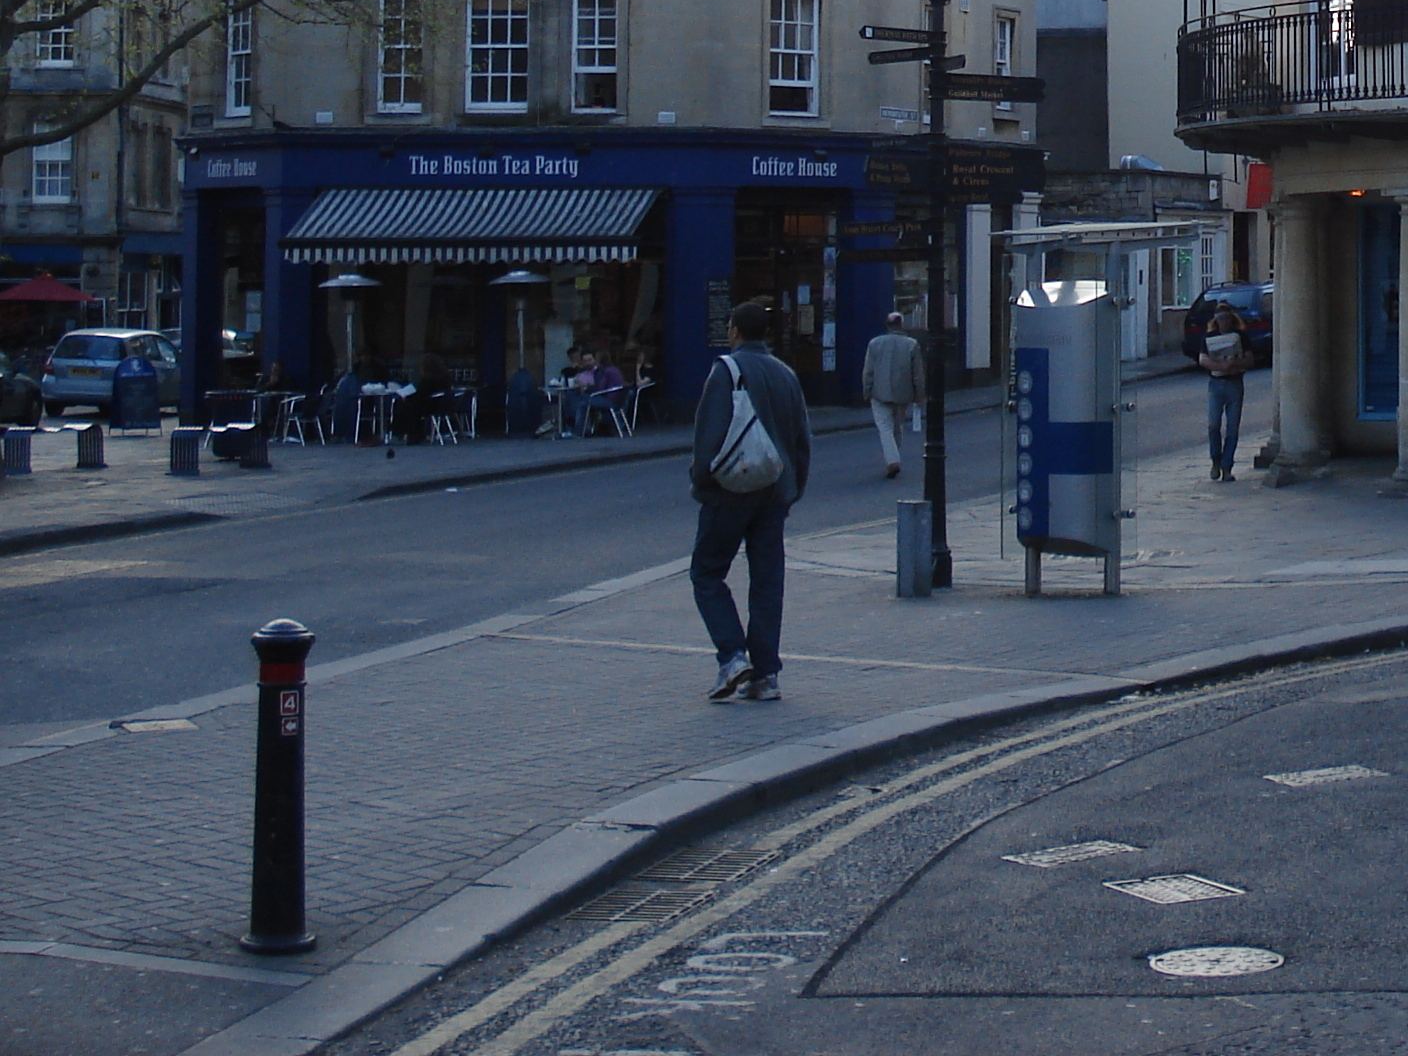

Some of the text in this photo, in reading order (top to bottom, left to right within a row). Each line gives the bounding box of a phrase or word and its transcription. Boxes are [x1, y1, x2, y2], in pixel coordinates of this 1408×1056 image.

[206, 159, 258, 178] Coffee House
[408, 155, 580, 179] The Boston Tea Party
[751, 156, 838, 177] Coffee House
[952, 164, 1014, 175] Royal Crescent
[963, 176, 990, 186] Circus
[284, 695, 296, 710] 4
